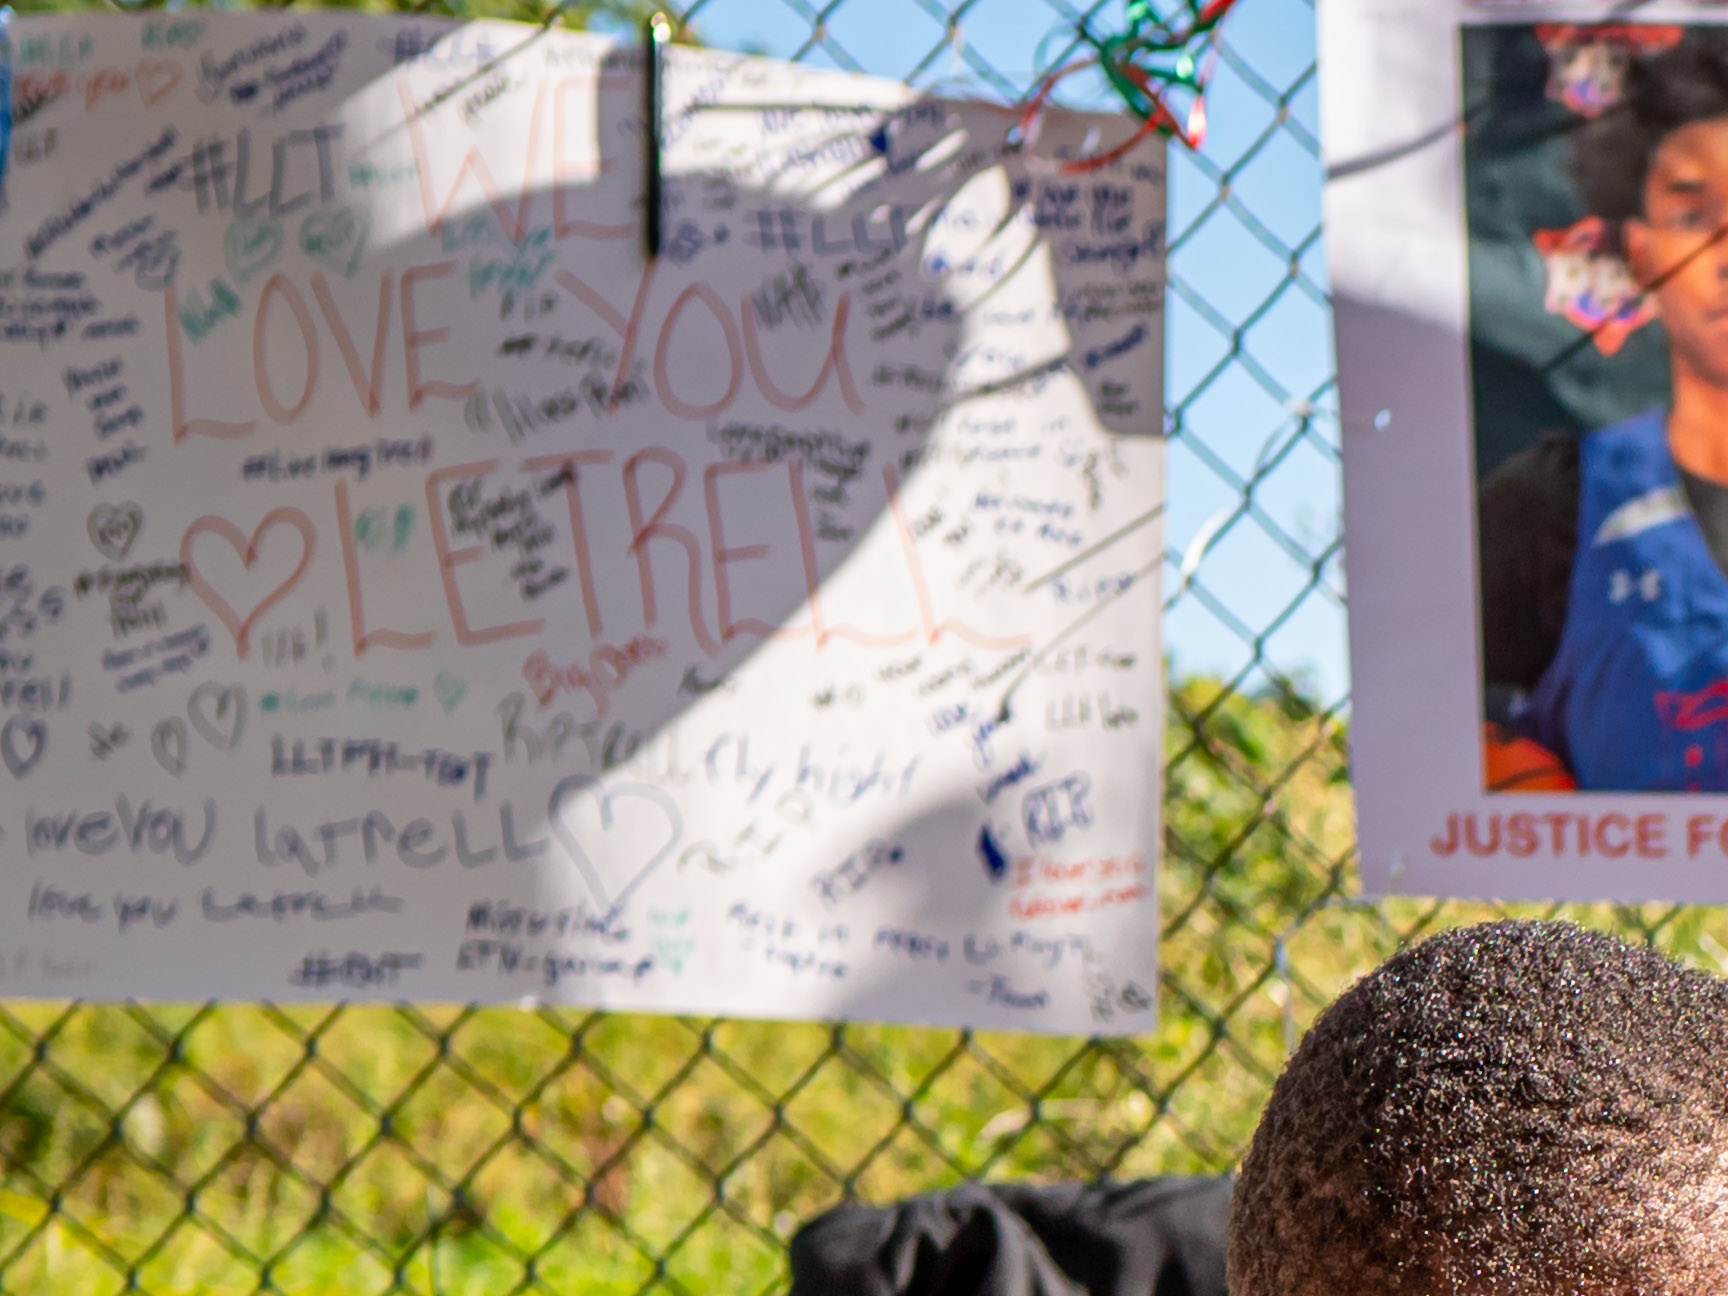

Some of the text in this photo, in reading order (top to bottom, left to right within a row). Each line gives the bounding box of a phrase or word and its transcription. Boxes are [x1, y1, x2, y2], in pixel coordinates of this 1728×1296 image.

[397, 72, 640, 244] WE
[163, 258, 481, 444] LOVE
[552, 256, 868, 420] YOU
[333, 444, 1036, 664] LETRELL
[1430, 811, 1667, 860] JUSTICE
